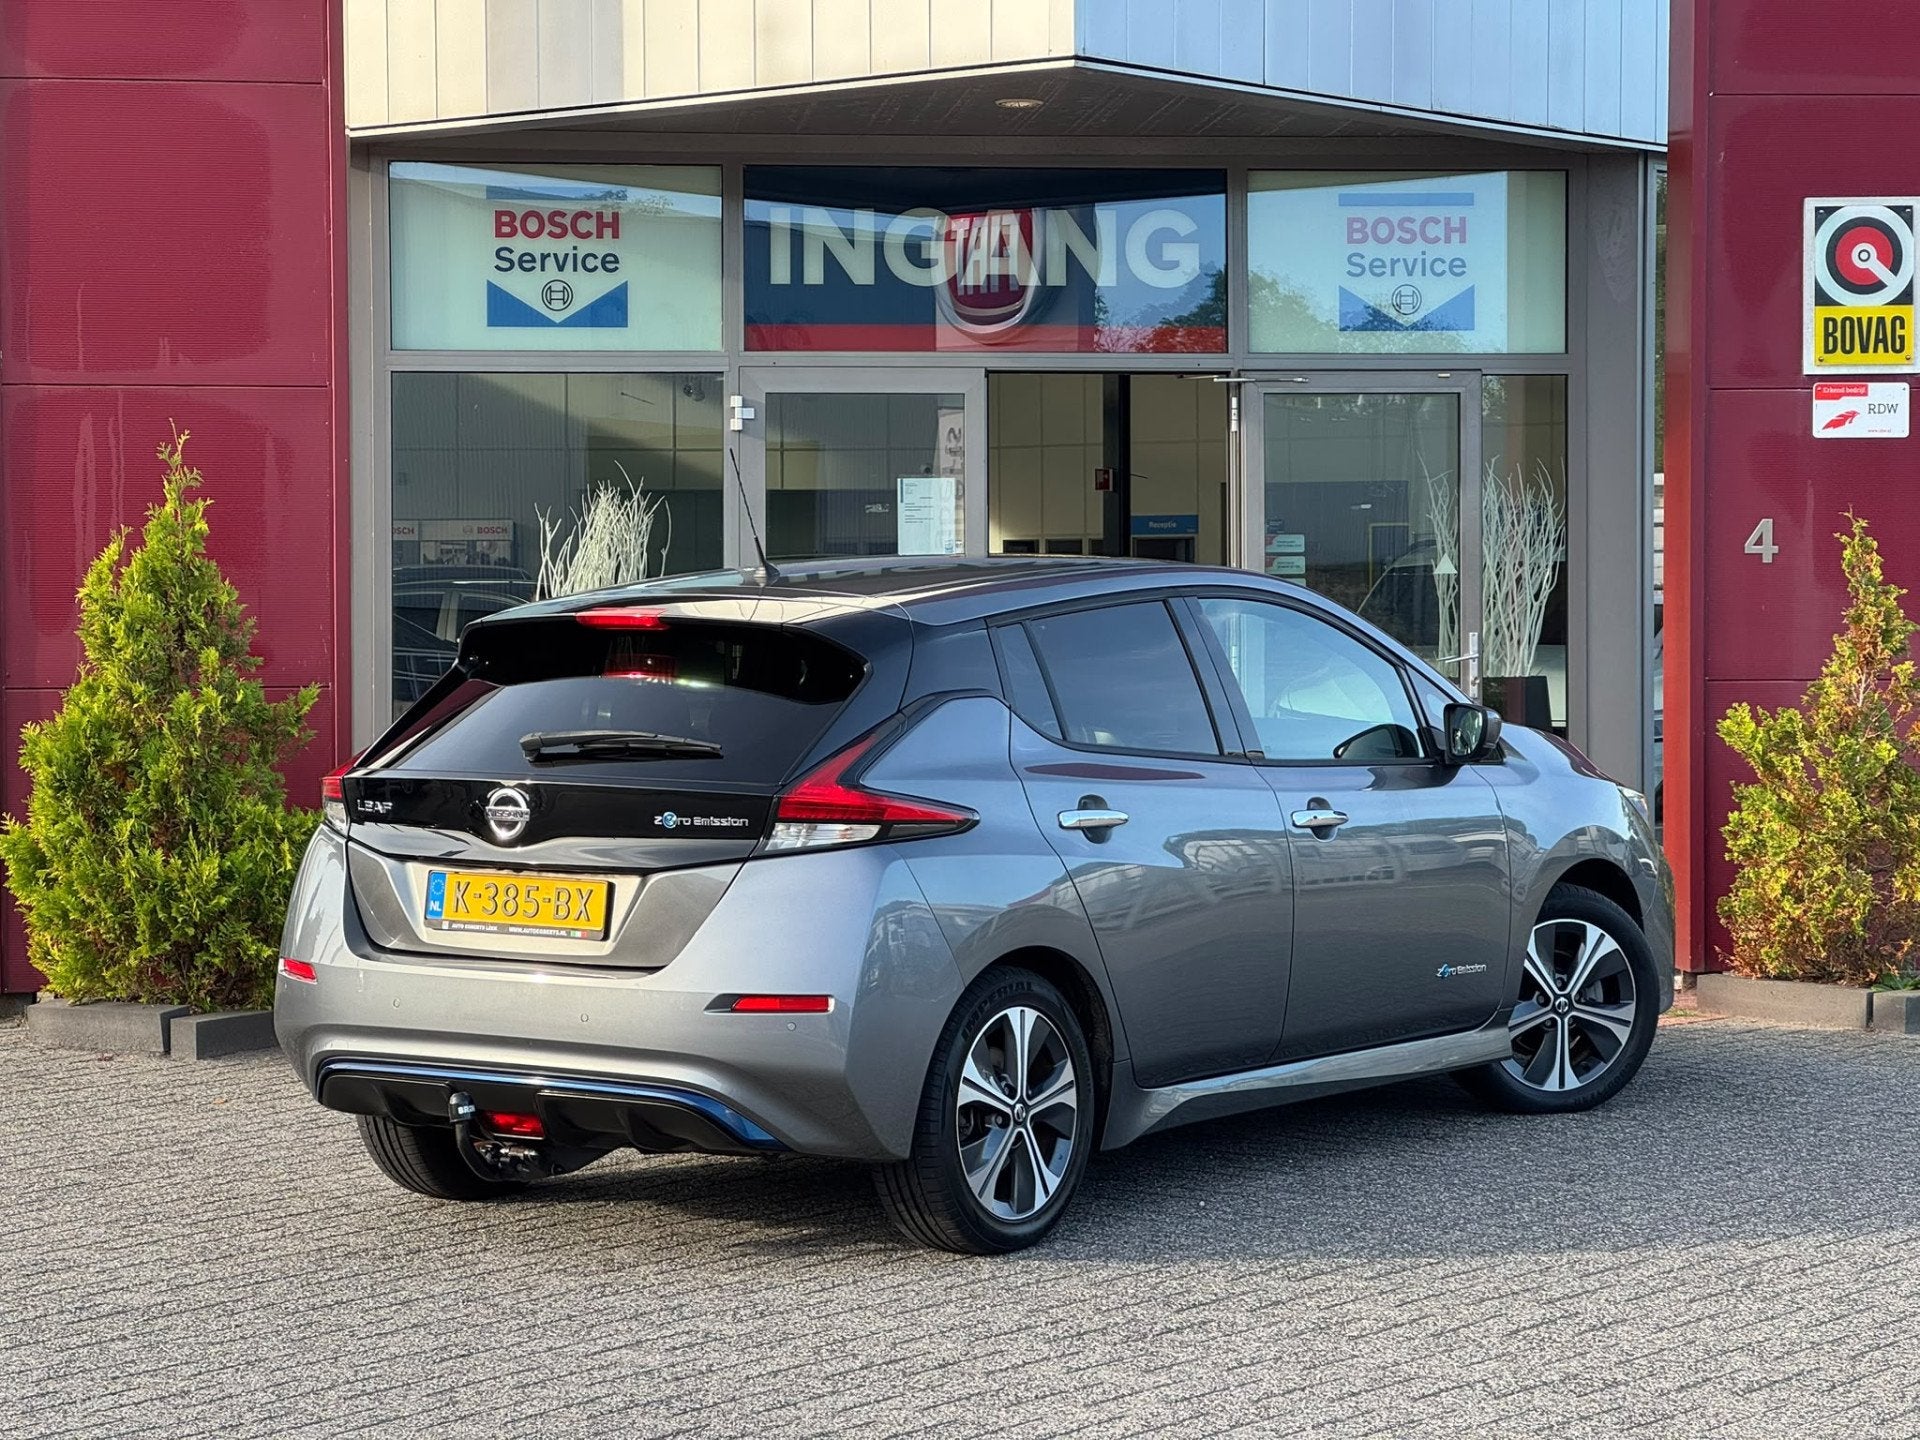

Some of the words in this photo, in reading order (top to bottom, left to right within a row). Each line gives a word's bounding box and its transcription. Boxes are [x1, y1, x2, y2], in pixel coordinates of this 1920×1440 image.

[494, 209, 620, 239] BOSCH
[1346, 216, 1467, 245] BOSCH
[494, 246, 620, 272] Service
[769, 206, 1200, 289] INGANG
[1346, 251, 1467, 277] Service
[1822, 315, 1906, 355] BOVAG
[1868, 403, 1899, 415] RDW
[392, 527, 415, 535] OSCH
[477, 526, 508, 534] BOSCH
[1744, 518, 1779, 563] 4
[357, 799, 393, 814] LEAF
[485, 808, 530, 820] NISSAN
[693, 816, 749, 827] Emission
[429, 900, 442, 912] NL
[453, 880, 593, 922] K-385-BX
